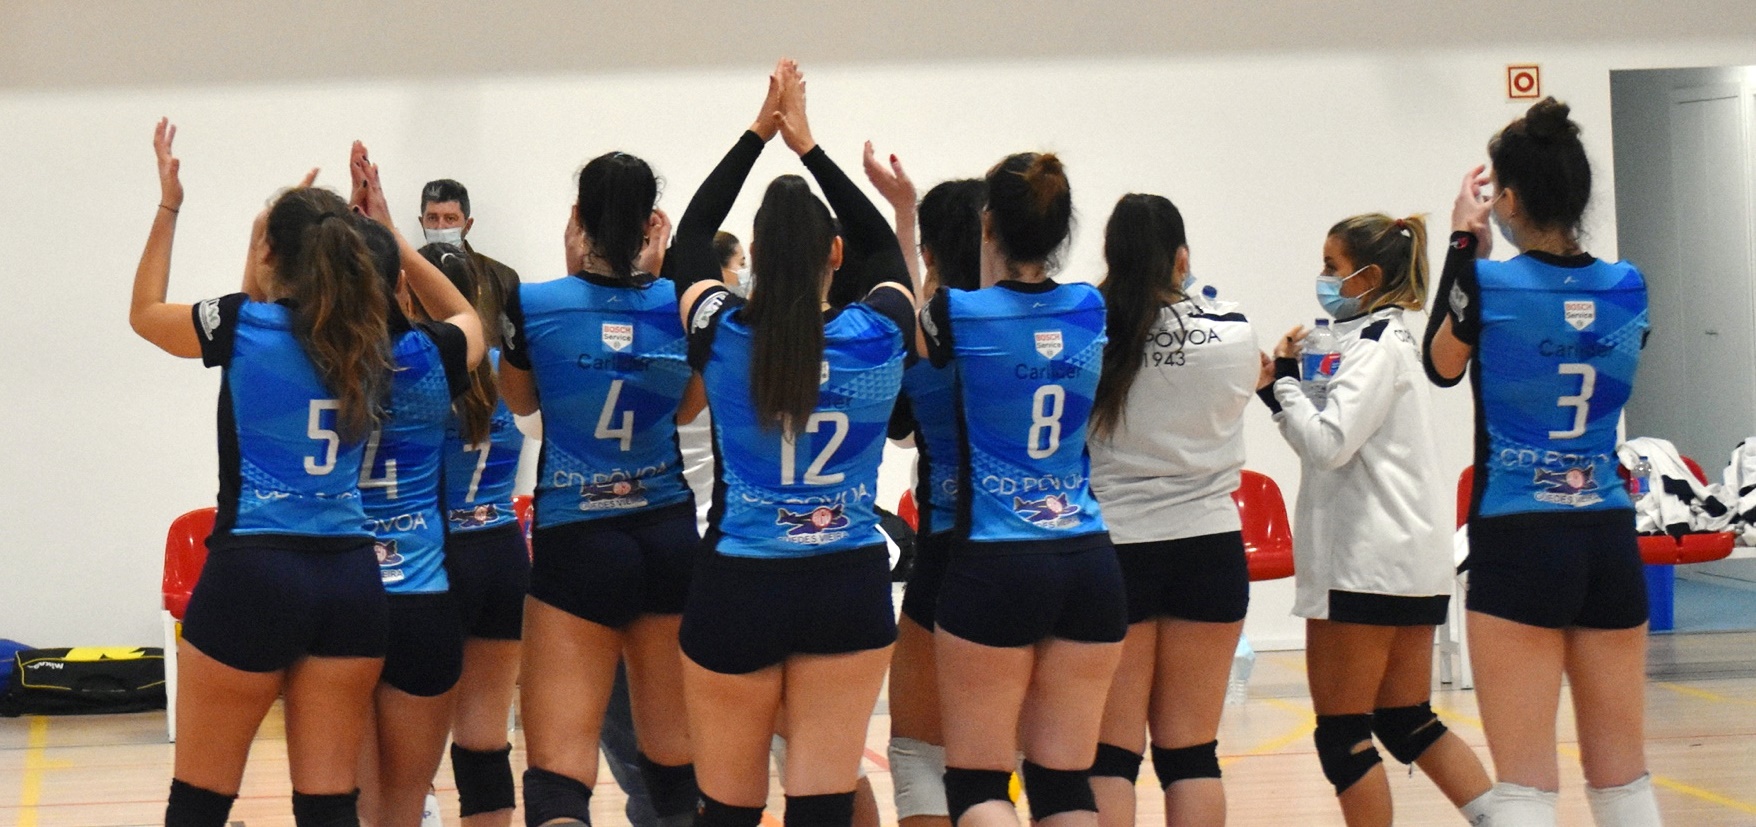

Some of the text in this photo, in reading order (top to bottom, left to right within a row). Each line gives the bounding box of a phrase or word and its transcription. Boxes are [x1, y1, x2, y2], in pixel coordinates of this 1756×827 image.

[604, 333, 631, 341] Service
[1036, 333, 1060, 341] BOSCH
[578, 353, 649, 371] Carler
[1143, 351, 1186, 367] 1943
[1015, 363, 1082, 380] Carler
[1548, 363, 1596, 439] 3
[594, 380, 634, 451] 4
[1027, 384, 1065, 459] 8
[303, 399, 341, 475] 5
[777, 411, 849, 486] 12
[1501, 449, 1537, 468] CD
[463, 442, 491, 503] 7
[942, 479, 959, 495] C
[982, 475, 1016, 495] CD
[382, 569, 404, 578] EIRA
